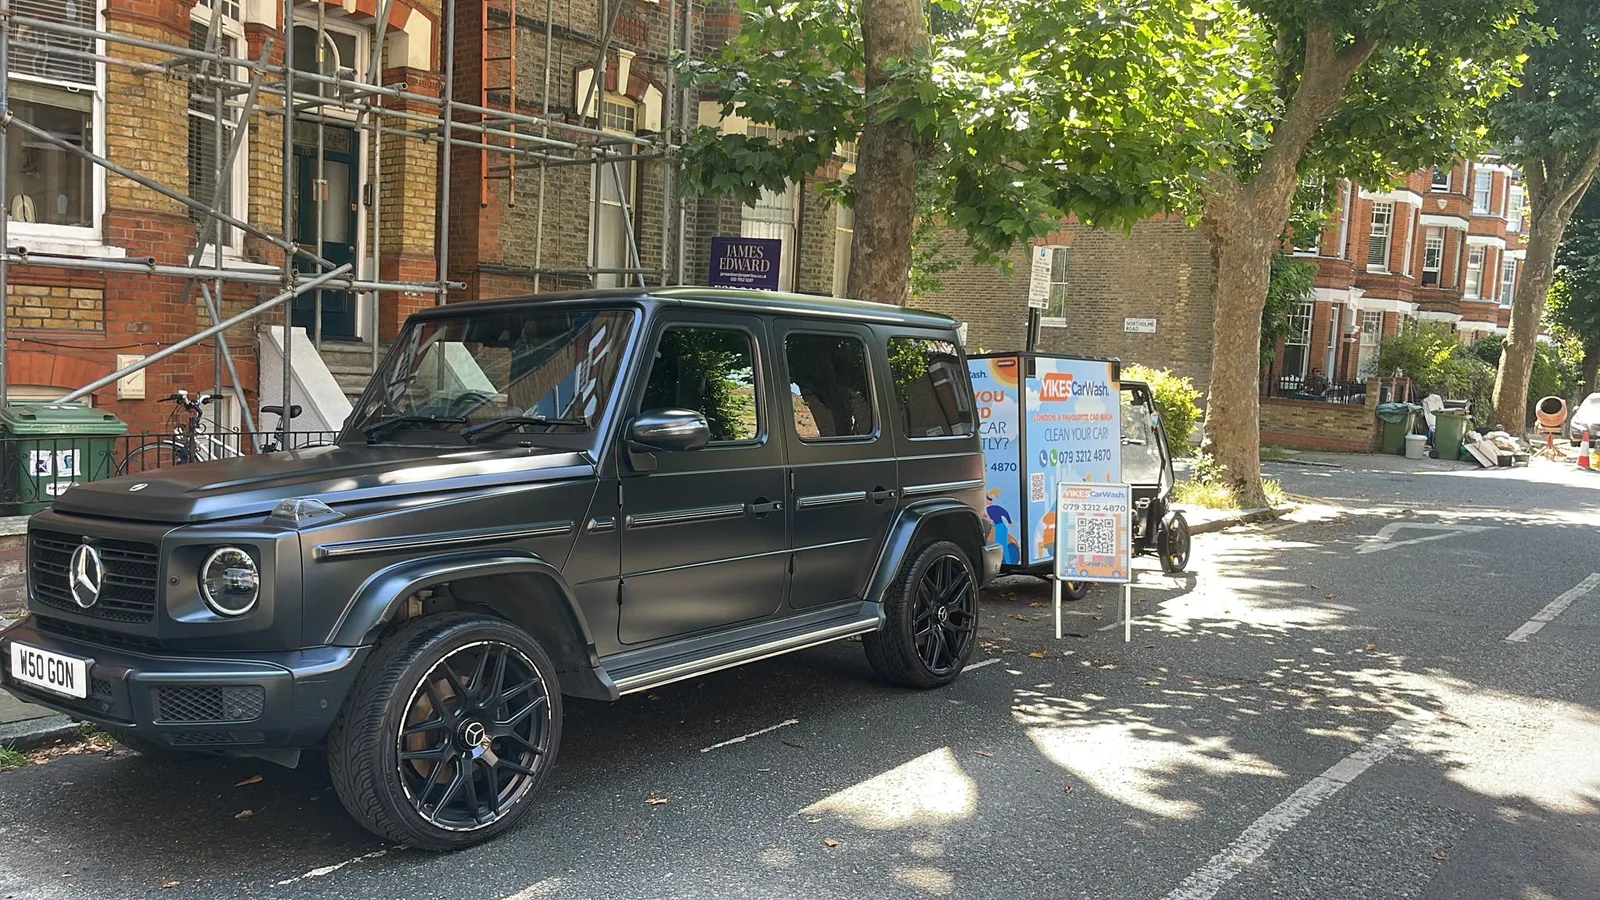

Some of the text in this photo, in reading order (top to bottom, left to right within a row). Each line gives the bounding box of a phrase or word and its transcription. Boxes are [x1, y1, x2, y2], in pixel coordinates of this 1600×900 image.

[726, 245, 764, 259] JAMES
[719, 257, 770, 272] EDWARD
[974, 390, 1004, 402] YOU
[978, 407, 991, 418] D
[1034, 414, 1056, 422] LONDON
[979, 421, 1006, 434] CAR
[1045, 427, 1109, 441] CLEAN YOUR CAR!
[981, 437, 1009, 450] TLY?
[1059, 449, 1111, 464] 079 3212 4870
[991, 462, 1017, 472] 4870
[1063, 503, 1079, 511] 079
[48, 657, 74, 689] GON
